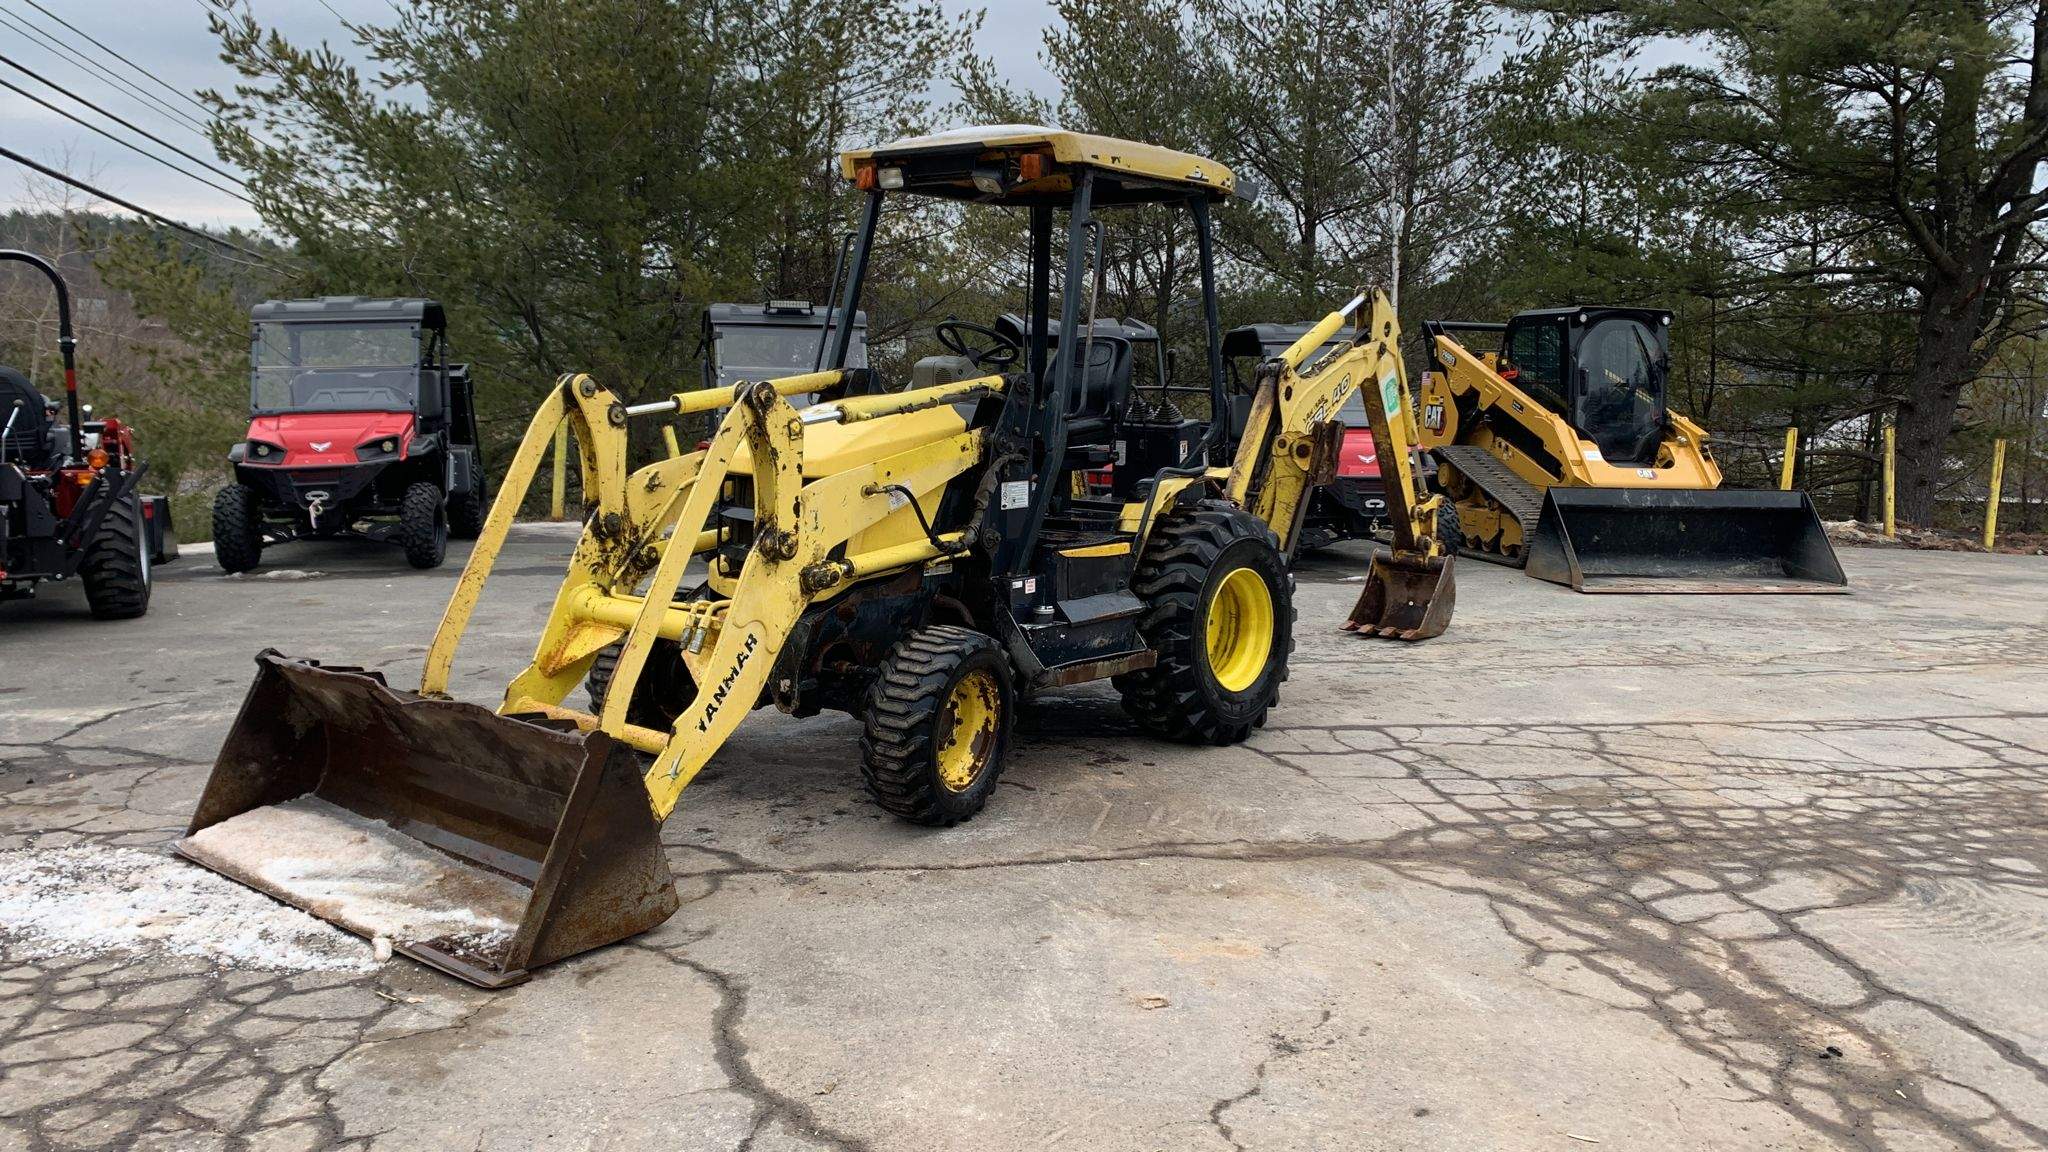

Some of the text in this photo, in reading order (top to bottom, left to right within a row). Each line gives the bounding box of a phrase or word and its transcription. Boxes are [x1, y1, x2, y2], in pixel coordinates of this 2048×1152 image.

[1425, 404, 1443, 429] CAT
[1637, 468, 1655, 480] CAT
[694, 633, 758, 733] YANMAR
